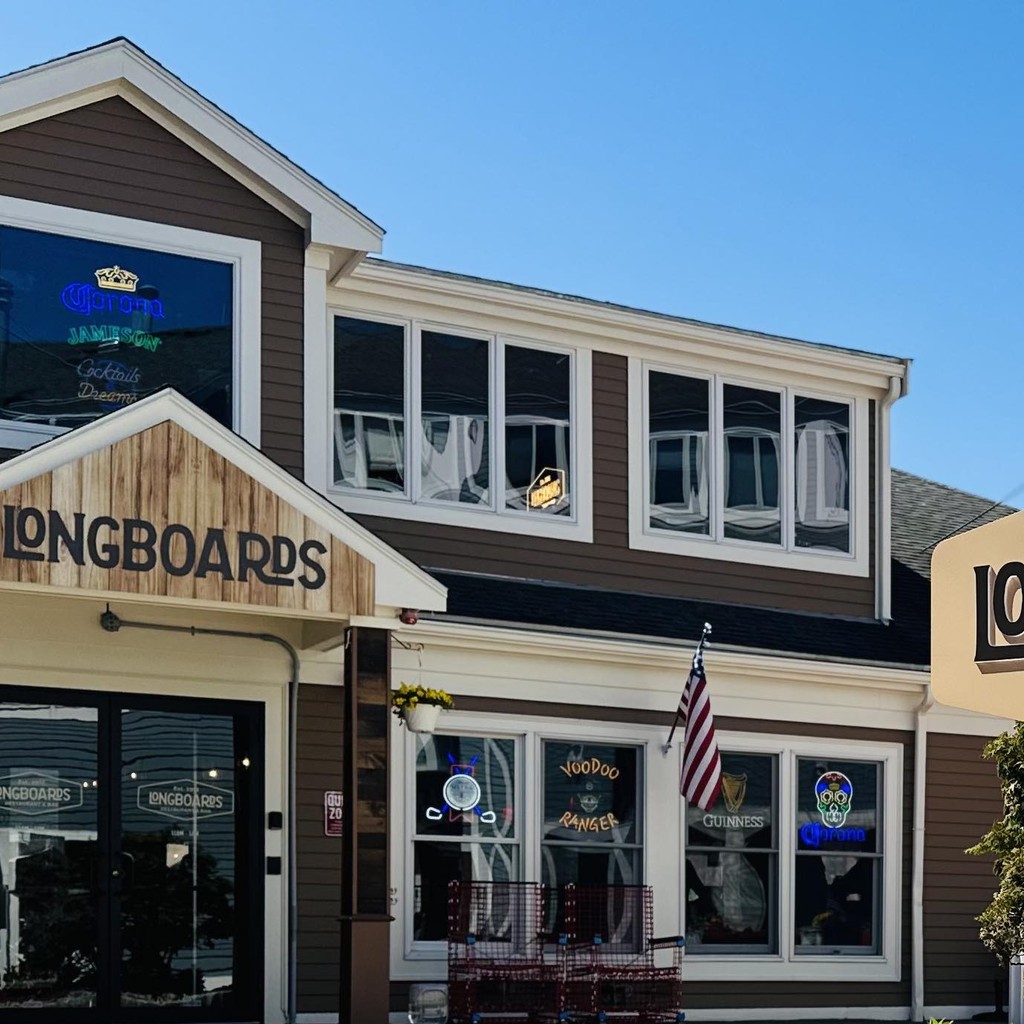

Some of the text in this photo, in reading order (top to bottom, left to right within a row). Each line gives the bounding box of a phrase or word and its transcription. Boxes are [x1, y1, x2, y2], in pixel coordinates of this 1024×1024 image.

[61, 283, 165, 319] Corona
[67, 325, 160, 352] JAMESON
[77, 358, 141, 383] Cocktails
[2, 503, 328, 590] LONGBOARDS
[560, 757, 620, 780] VOODOO
[0, 786, 71, 802] NGBOARDS
[148, 791, 223, 808] LONGBOARDS
[329, 807, 343, 820] ZO
[559, 811, 620, 833] RANGER
[703, 814, 764, 828] GUINNESS
[801, 822, 867, 848] Corona
